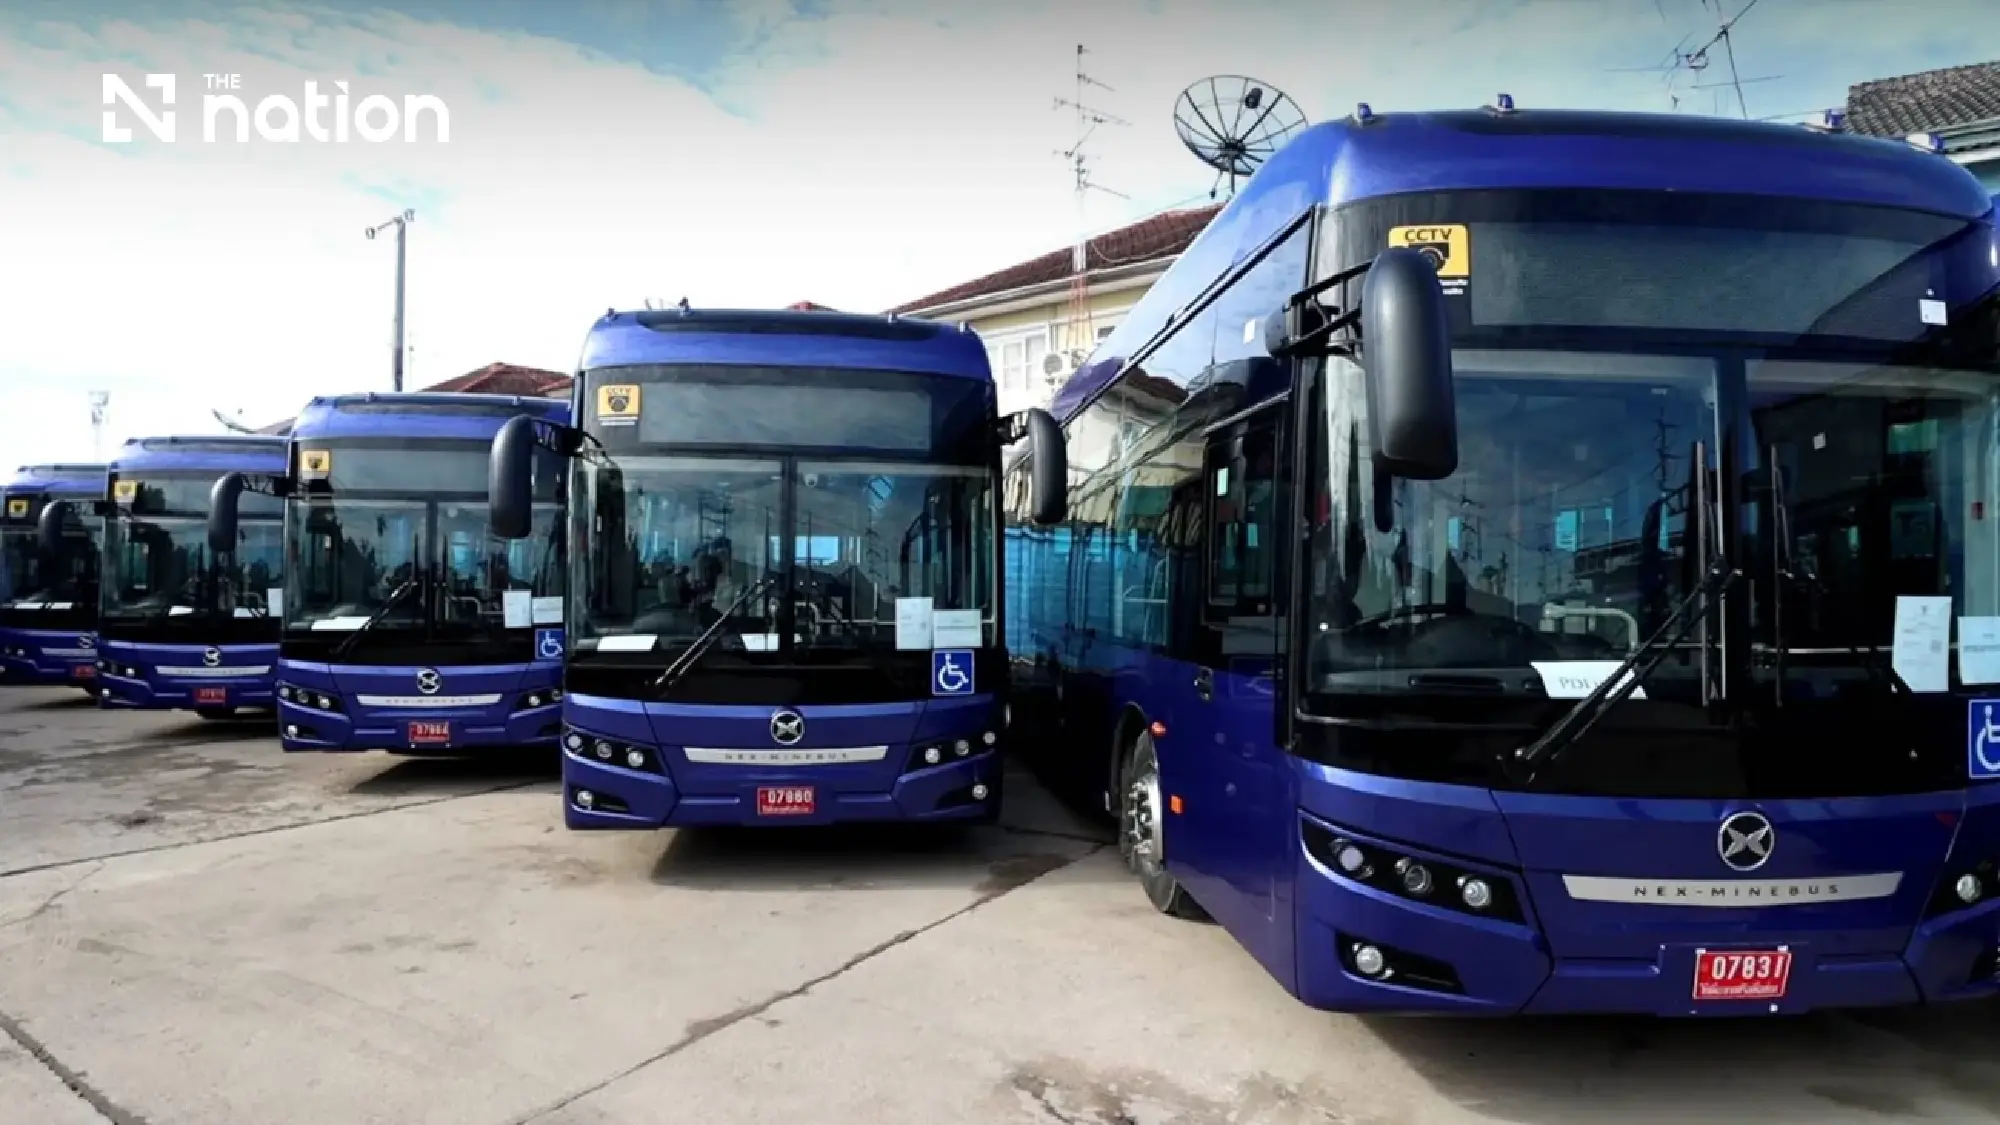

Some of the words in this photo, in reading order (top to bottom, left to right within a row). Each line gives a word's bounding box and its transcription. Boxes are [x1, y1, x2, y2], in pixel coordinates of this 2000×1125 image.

[1404, 228, 1452, 241] CCTV
[1634, 884, 1839, 898] NEX-MINEBUS
[1711, 955, 1785, 980] 07831
